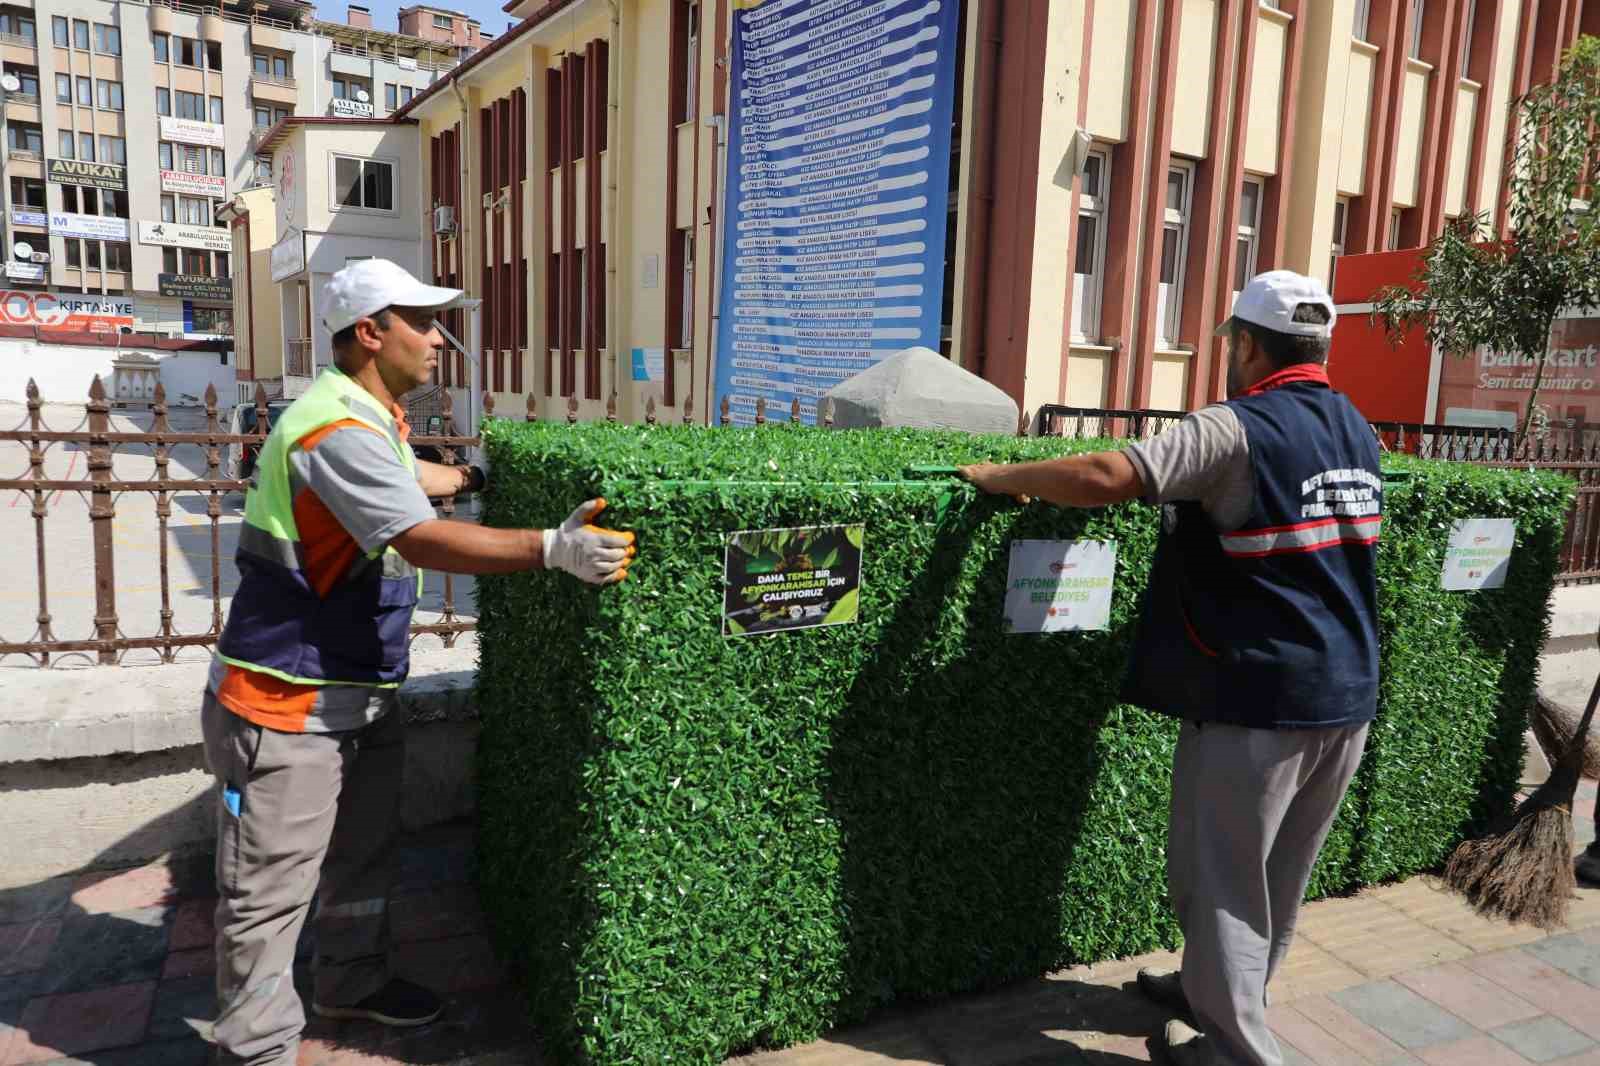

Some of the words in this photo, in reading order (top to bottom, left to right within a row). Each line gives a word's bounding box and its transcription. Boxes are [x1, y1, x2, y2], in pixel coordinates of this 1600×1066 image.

[52, 160, 122, 179] AVUKAT
[53, 216, 67, 227] M
[175, 275, 218, 284] AVUKAT
[1478, 373, 1510, 389] Seni
[1512, 373, 1575, 390] düünür
[758, 574, 785, 584] DAHA
[786, 571, 813, 581] TEMİZ
[815, 569, 831, 578] BİR
[741, 579, 826, 594] AFYONKARAHİSAR
[827, 577, 846, 587] İÇİN
[763, 588, 823, 602] ÇALIŞIYORUZ
